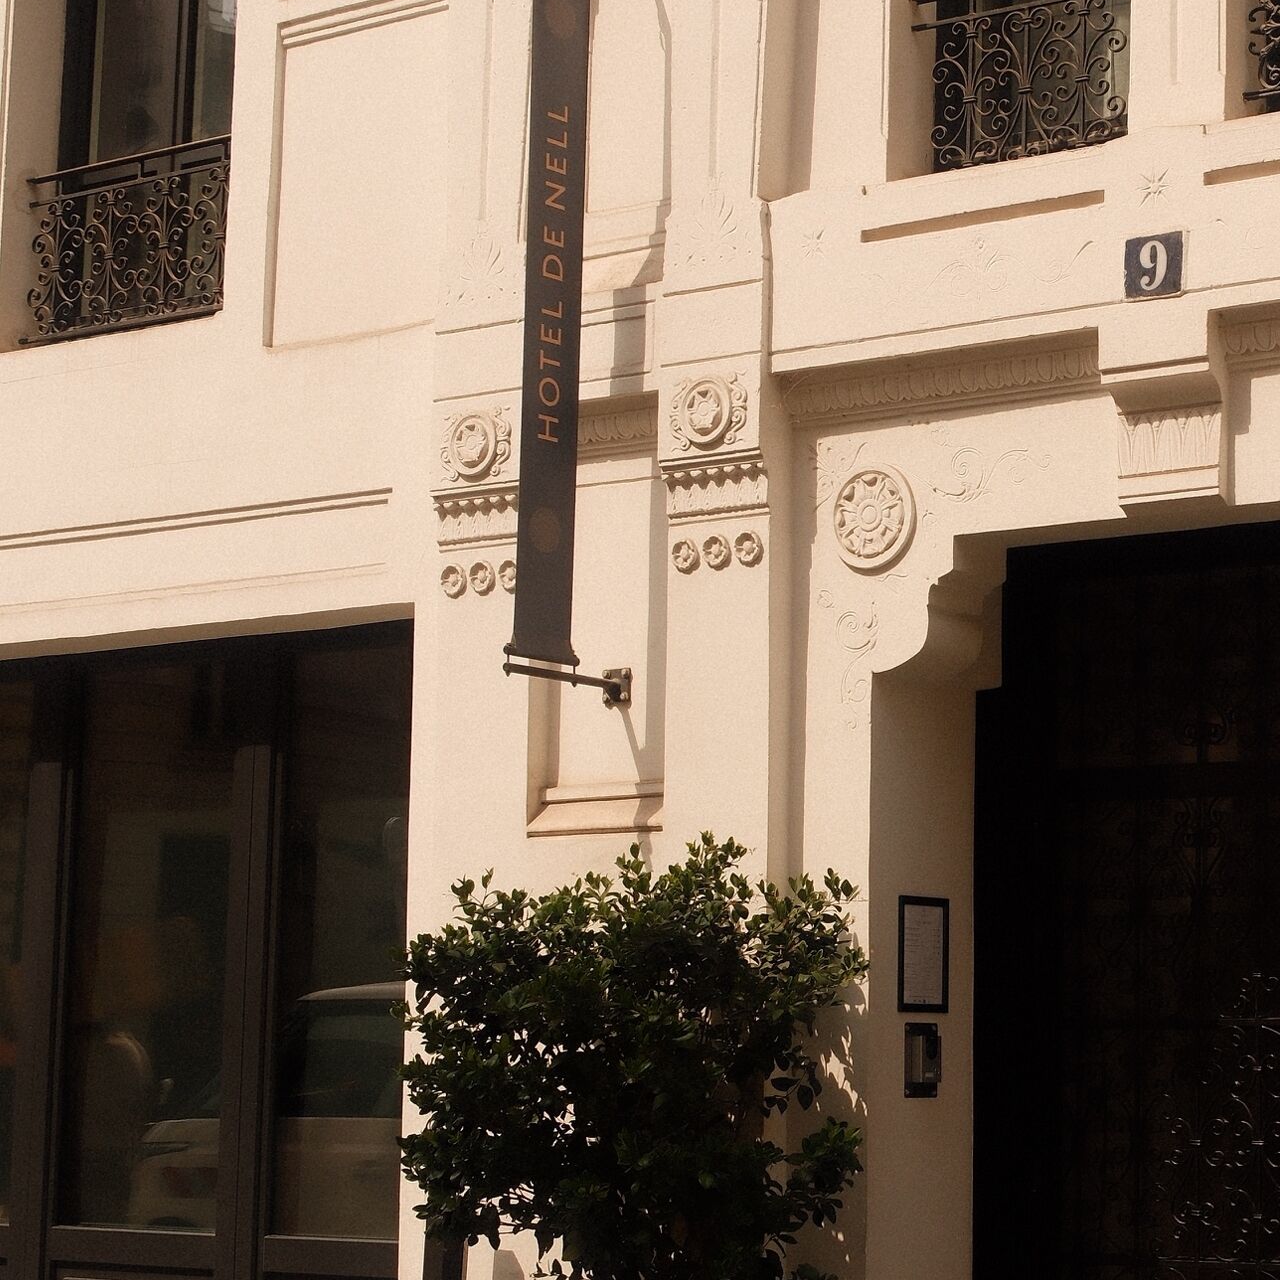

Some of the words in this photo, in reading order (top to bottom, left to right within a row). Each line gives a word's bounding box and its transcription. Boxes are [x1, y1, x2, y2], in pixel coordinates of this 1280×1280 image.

[544, 105, 569, 211] NELL
[542, 225, 566, 282] DE
[1139, 239, 1168, 291] 9
[537, 300, 564, 443] HOTEL
